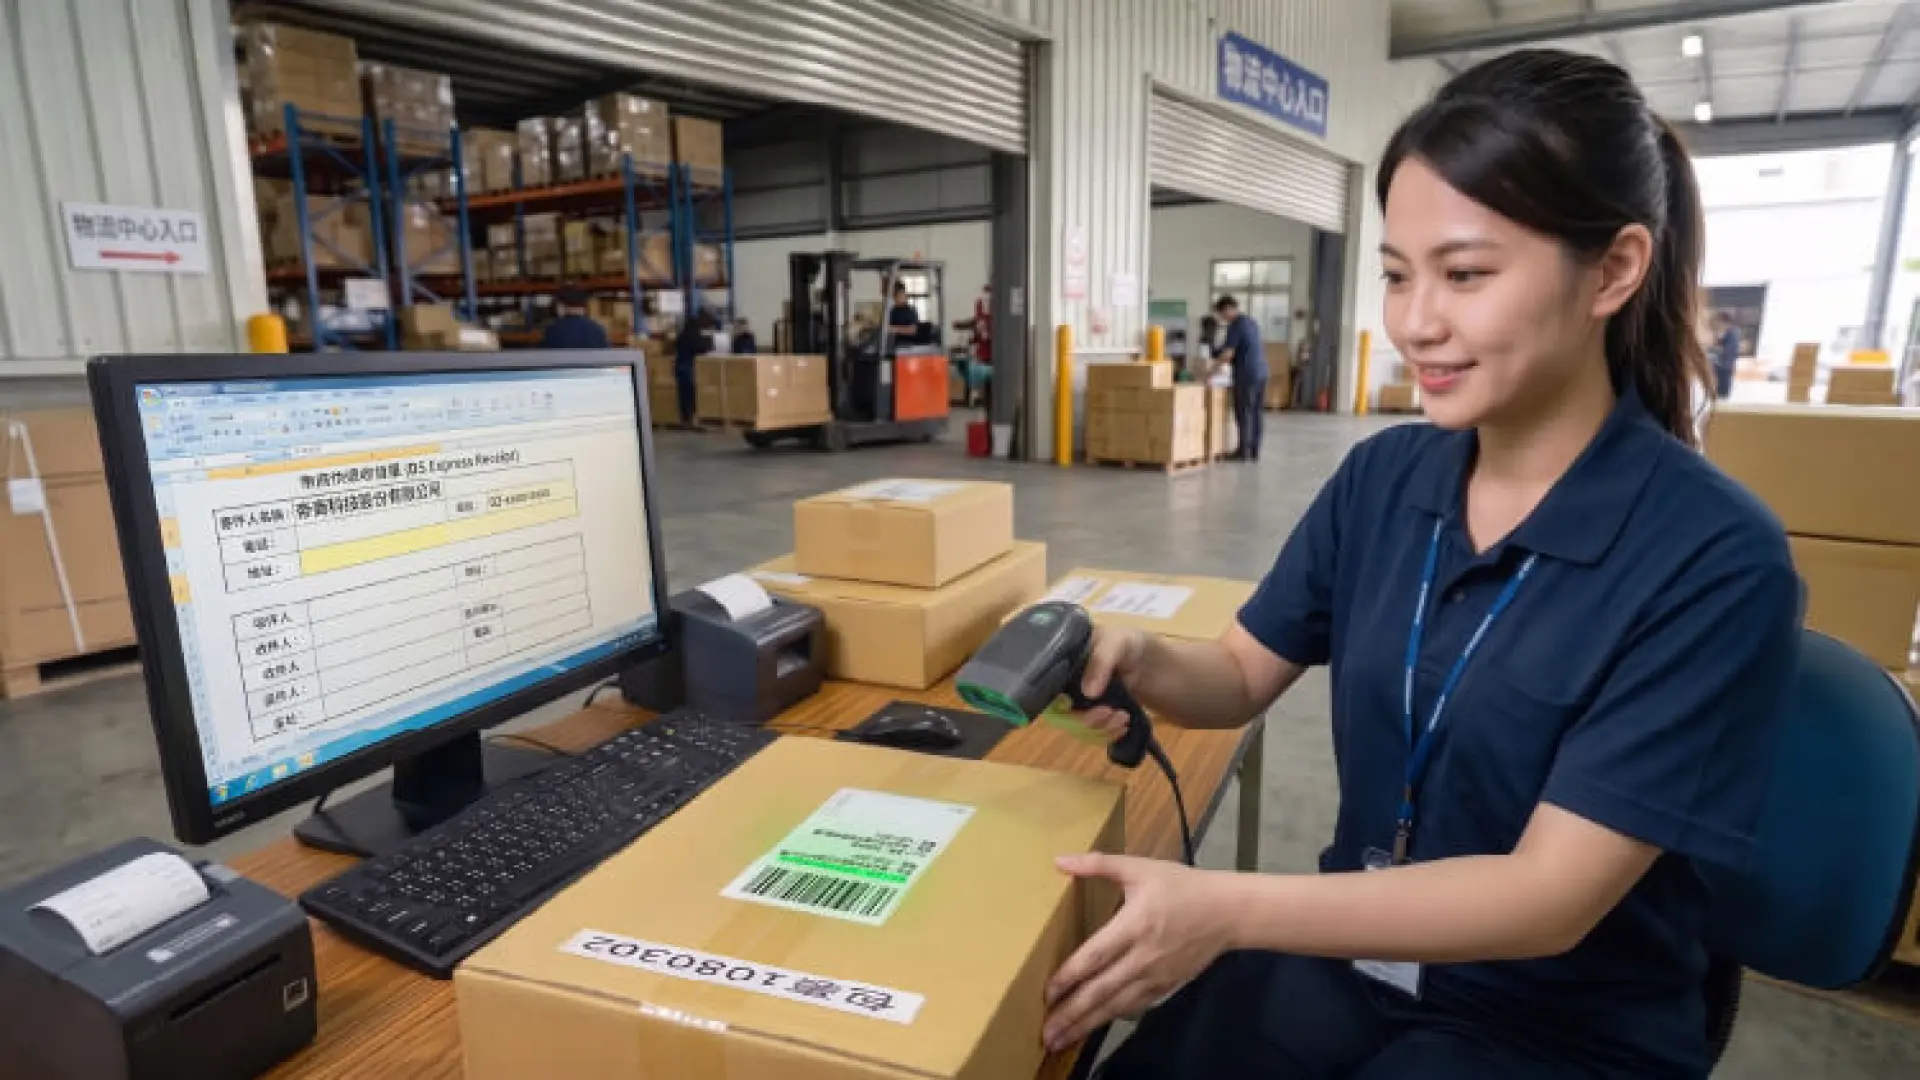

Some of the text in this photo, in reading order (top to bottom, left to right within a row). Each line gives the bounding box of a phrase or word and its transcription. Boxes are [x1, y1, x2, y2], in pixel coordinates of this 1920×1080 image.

[1224, 42, 1323, 123] 物流中心入口
[73, 212, 198, 243] 物流中心入口
